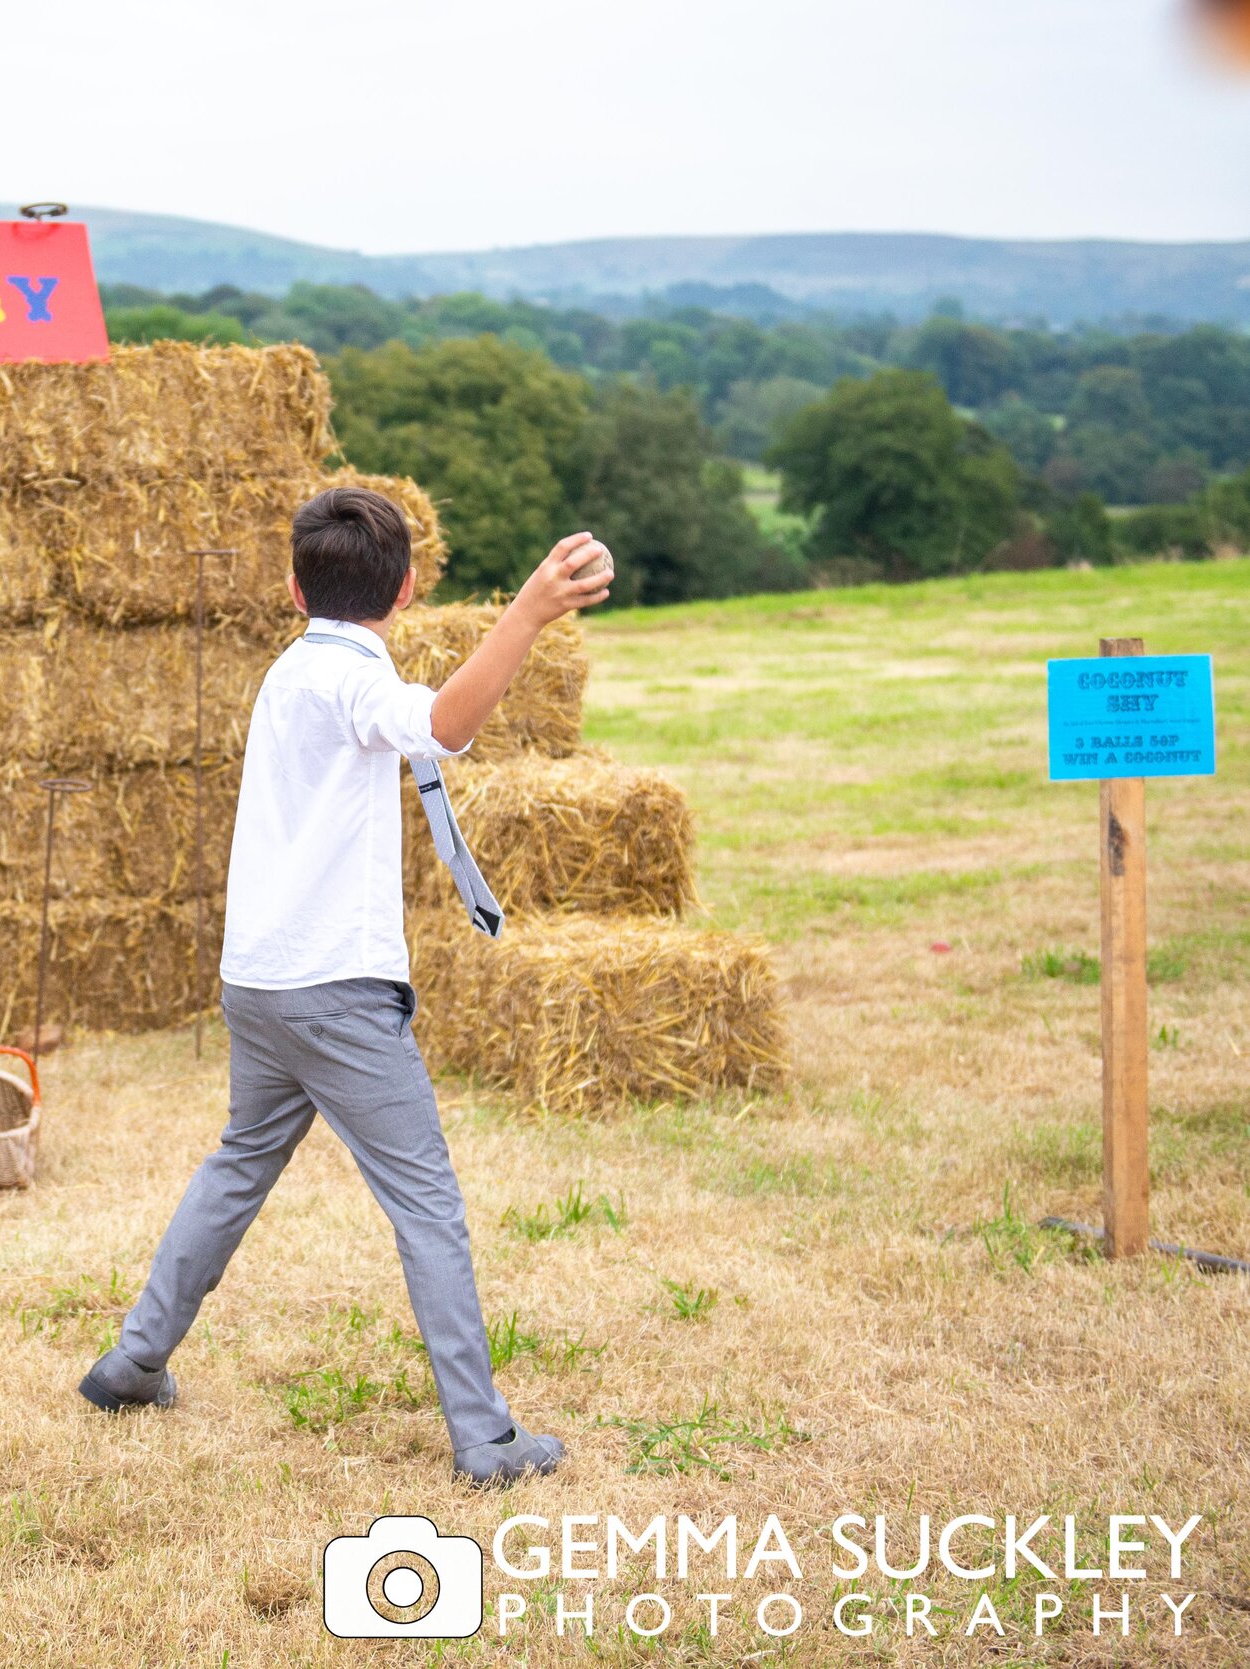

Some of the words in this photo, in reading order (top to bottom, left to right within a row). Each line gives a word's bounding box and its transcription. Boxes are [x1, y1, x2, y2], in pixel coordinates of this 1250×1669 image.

[1077, 670, 1189, 690] COCONUT
[1106, 694, 1159, 712] SHY
[1091, 736, 1143, 748] BALLS
[1062, 753, 1098, 766] WIN
[1104, 752, 1118, 764] A
[1124, 750, 1202, 764] COCONUT
